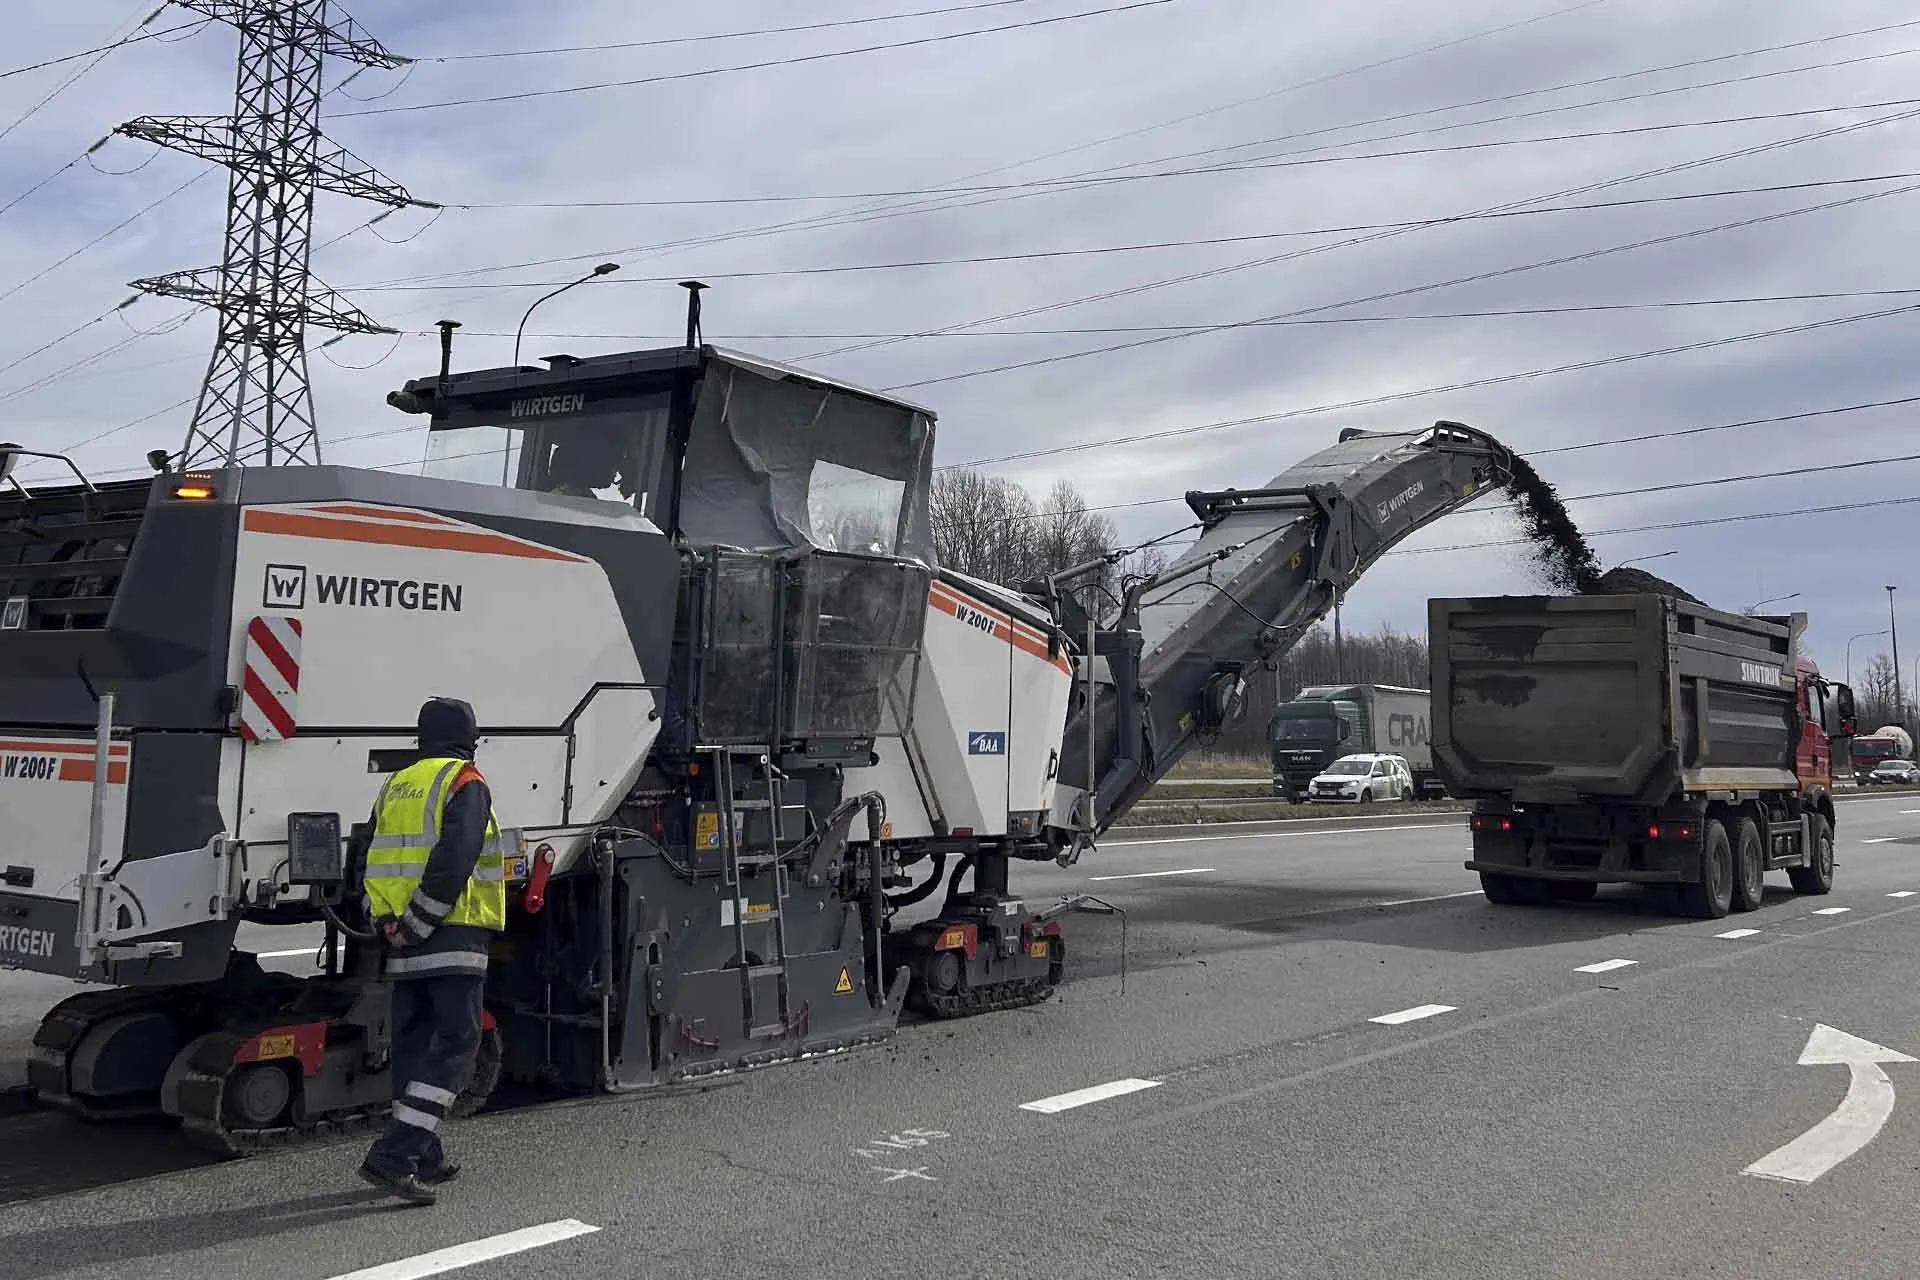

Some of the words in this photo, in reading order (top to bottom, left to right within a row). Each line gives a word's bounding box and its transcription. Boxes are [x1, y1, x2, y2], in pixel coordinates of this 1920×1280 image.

[511, 394, 585, 417] WIRTGEN
[1388, 480, 1424, 512] WIRTGEN
[315, 574, 463, 612] WIRTGEN
[956, 604, 968, 621] W
[967, 610, 995, 634] 200F
[4, 755, 19, 778] W
[19, 756, 57, 780] 200F
